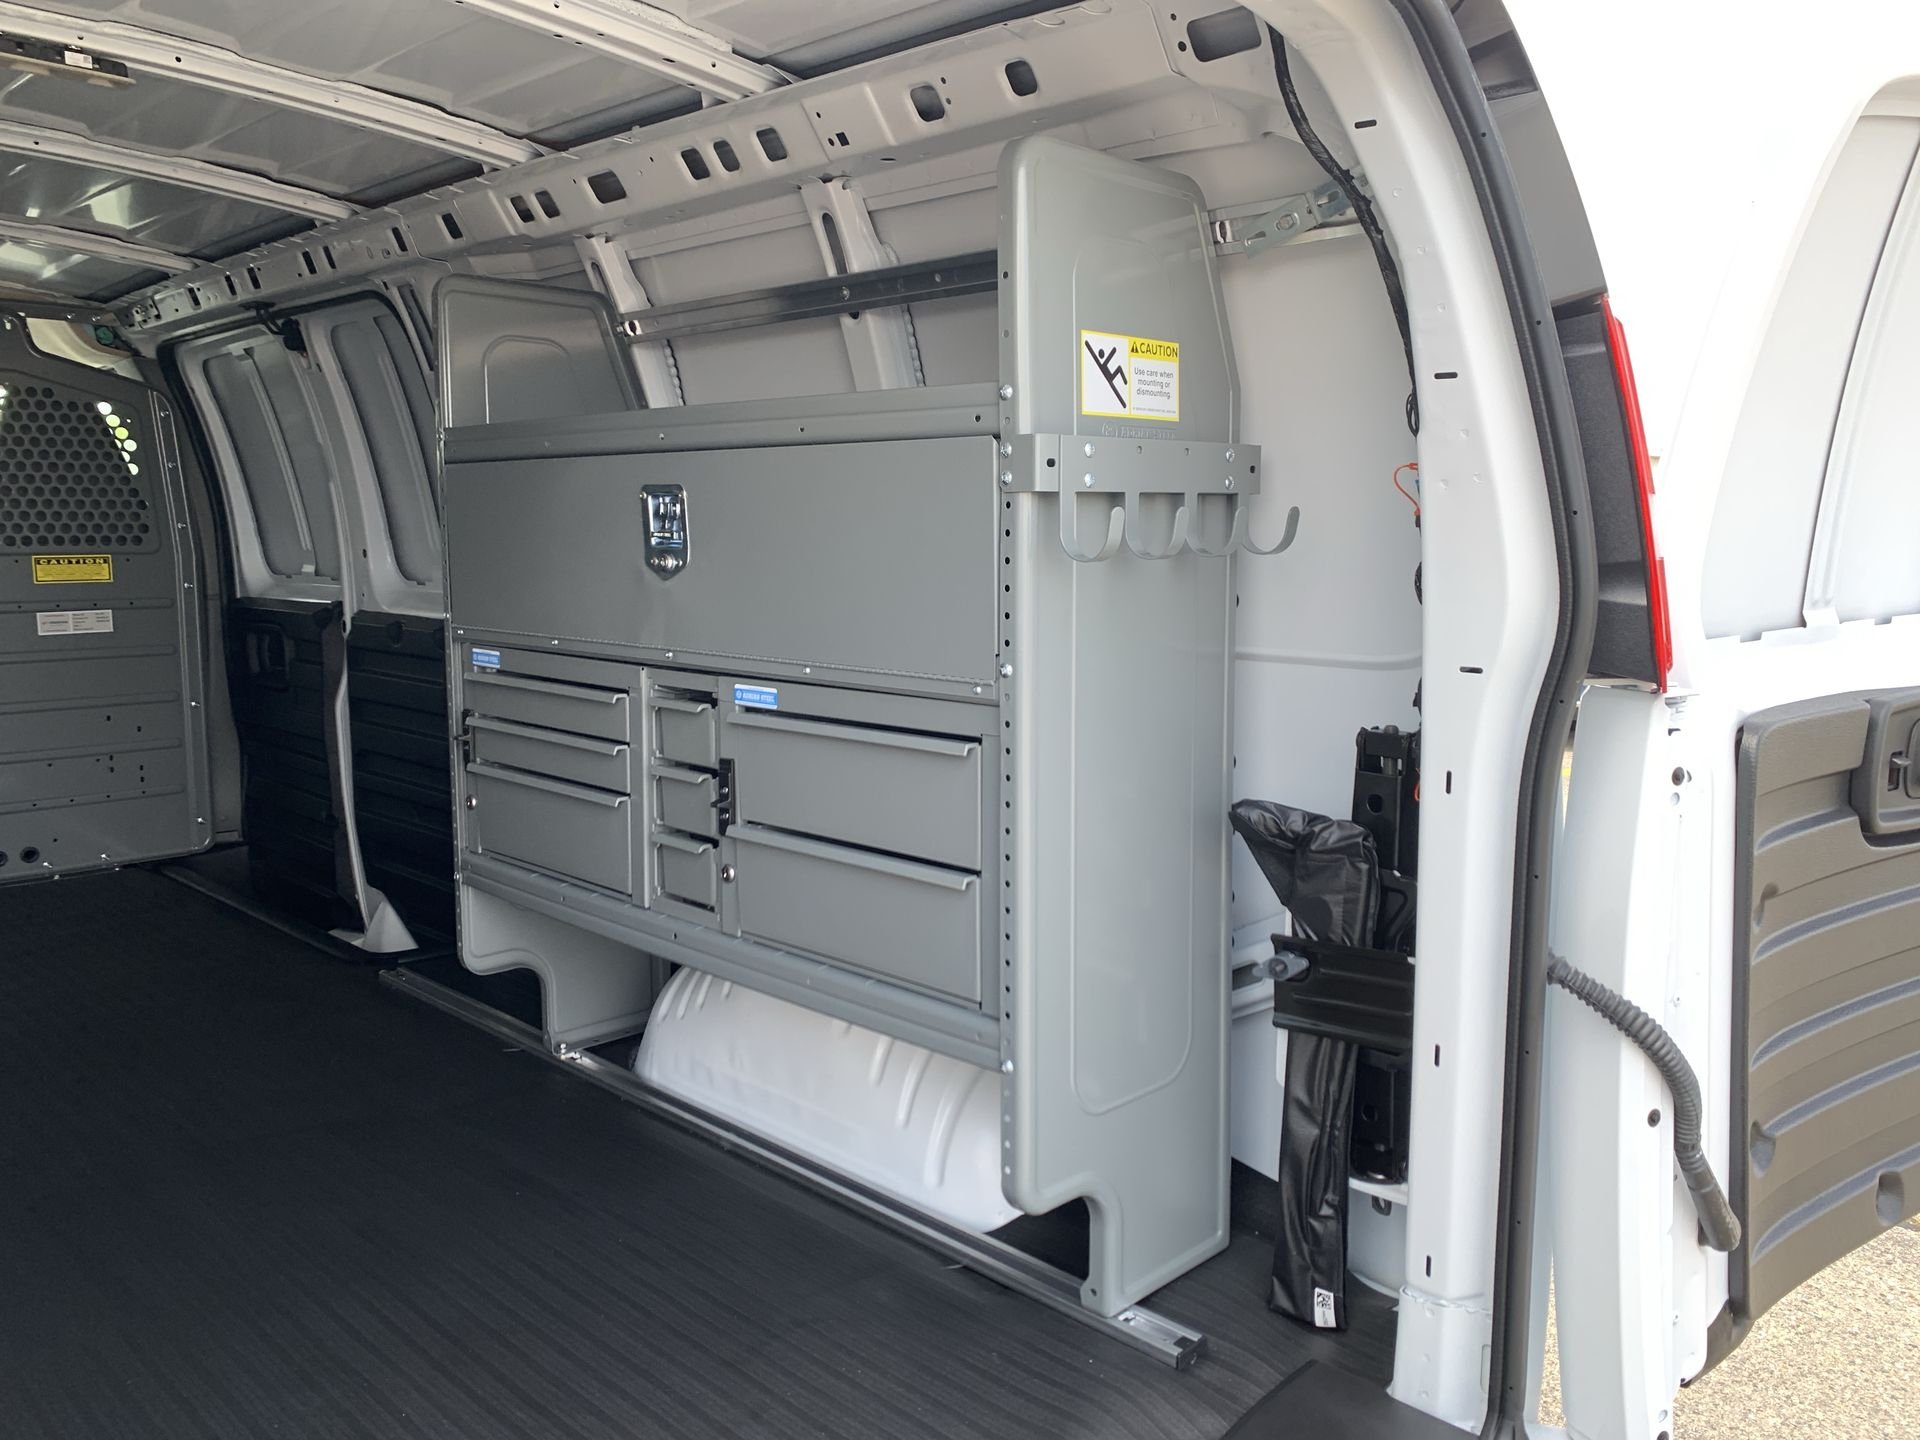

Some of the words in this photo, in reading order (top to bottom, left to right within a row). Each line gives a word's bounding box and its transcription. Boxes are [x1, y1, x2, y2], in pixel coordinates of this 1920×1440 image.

[1140, 342, 1178, 358] CAUTION
[1134, 367, 1145, 375] Use
[1159, 370, 1174, 379] when
[1137, 377, 1164, 389] mounting
[1136, 387, 1171, 400] dismounting
